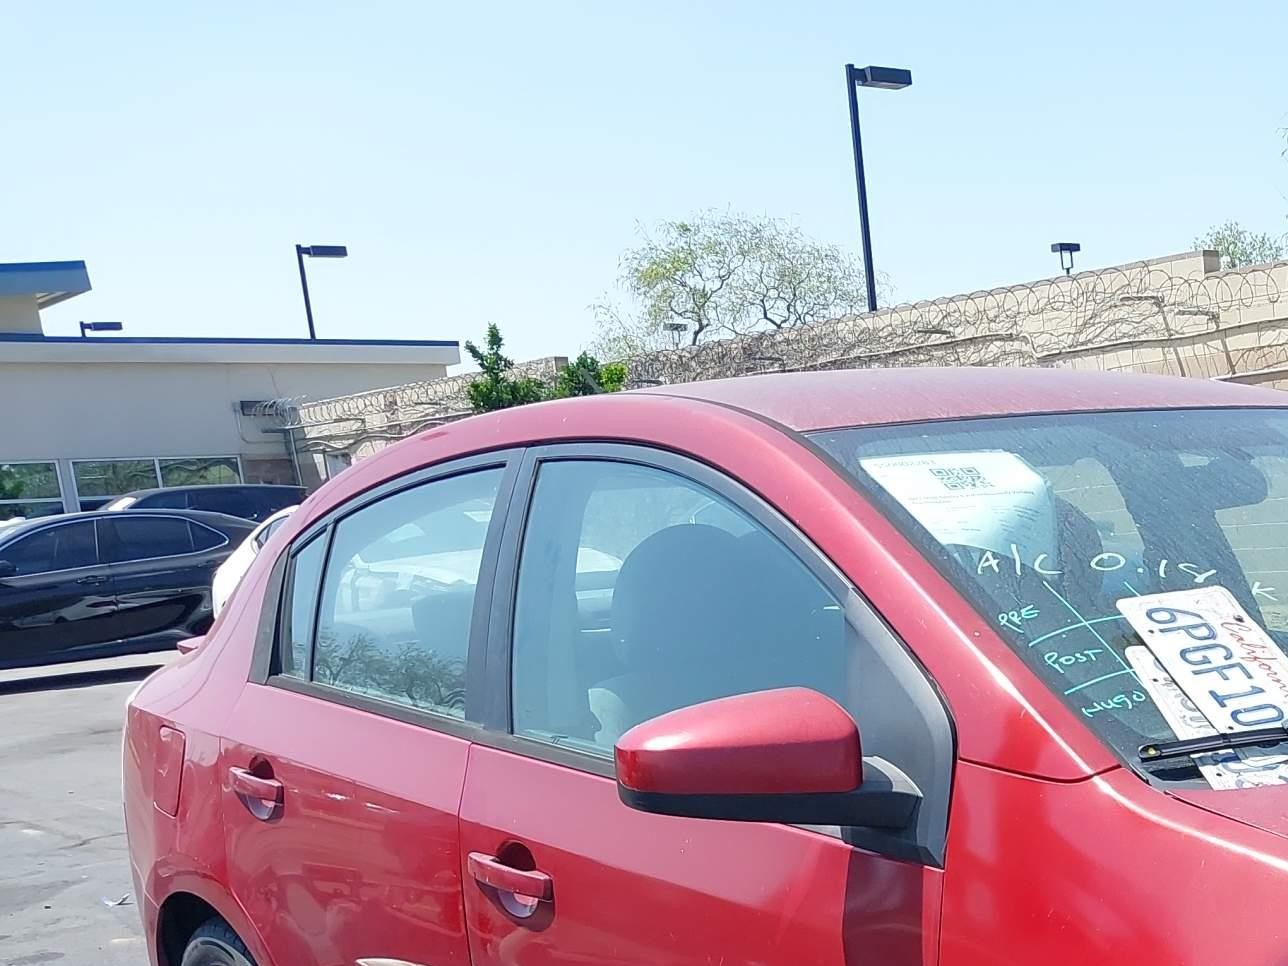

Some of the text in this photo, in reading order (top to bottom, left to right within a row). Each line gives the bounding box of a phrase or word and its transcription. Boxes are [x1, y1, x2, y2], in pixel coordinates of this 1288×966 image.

[977, 543, 1065, 577] A/C
[998, 604, 1040, 633] PRE
[1044, 649, 1104, 674] POST
[1145, 606, 1285, 730] 6PGF10
